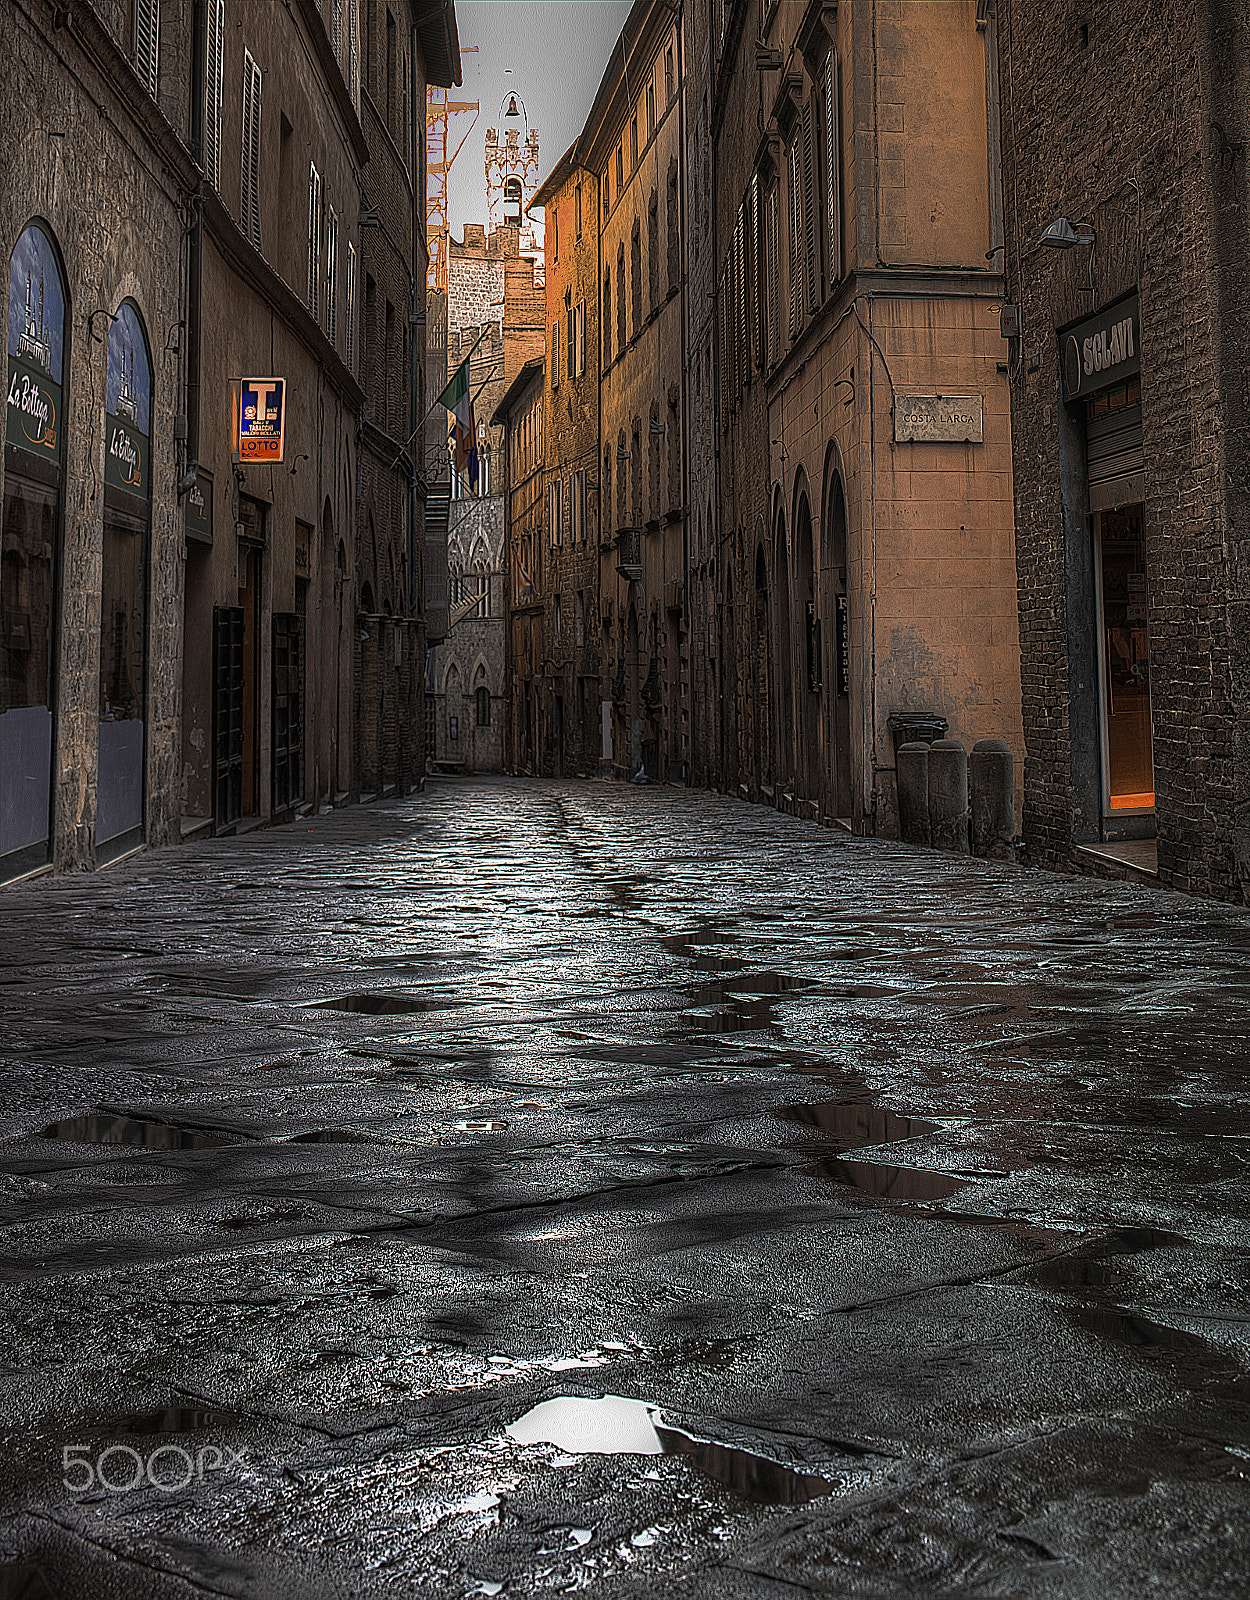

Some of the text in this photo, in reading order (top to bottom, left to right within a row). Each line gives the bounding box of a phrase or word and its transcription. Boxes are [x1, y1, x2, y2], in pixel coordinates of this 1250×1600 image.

[1083, 317, 1134, 376] SCLAVI
[248, 383, 276, 421] T
[903, 414, 975, 423] COSTA LARGA
[241, 440, 279, 451] LOTTO
